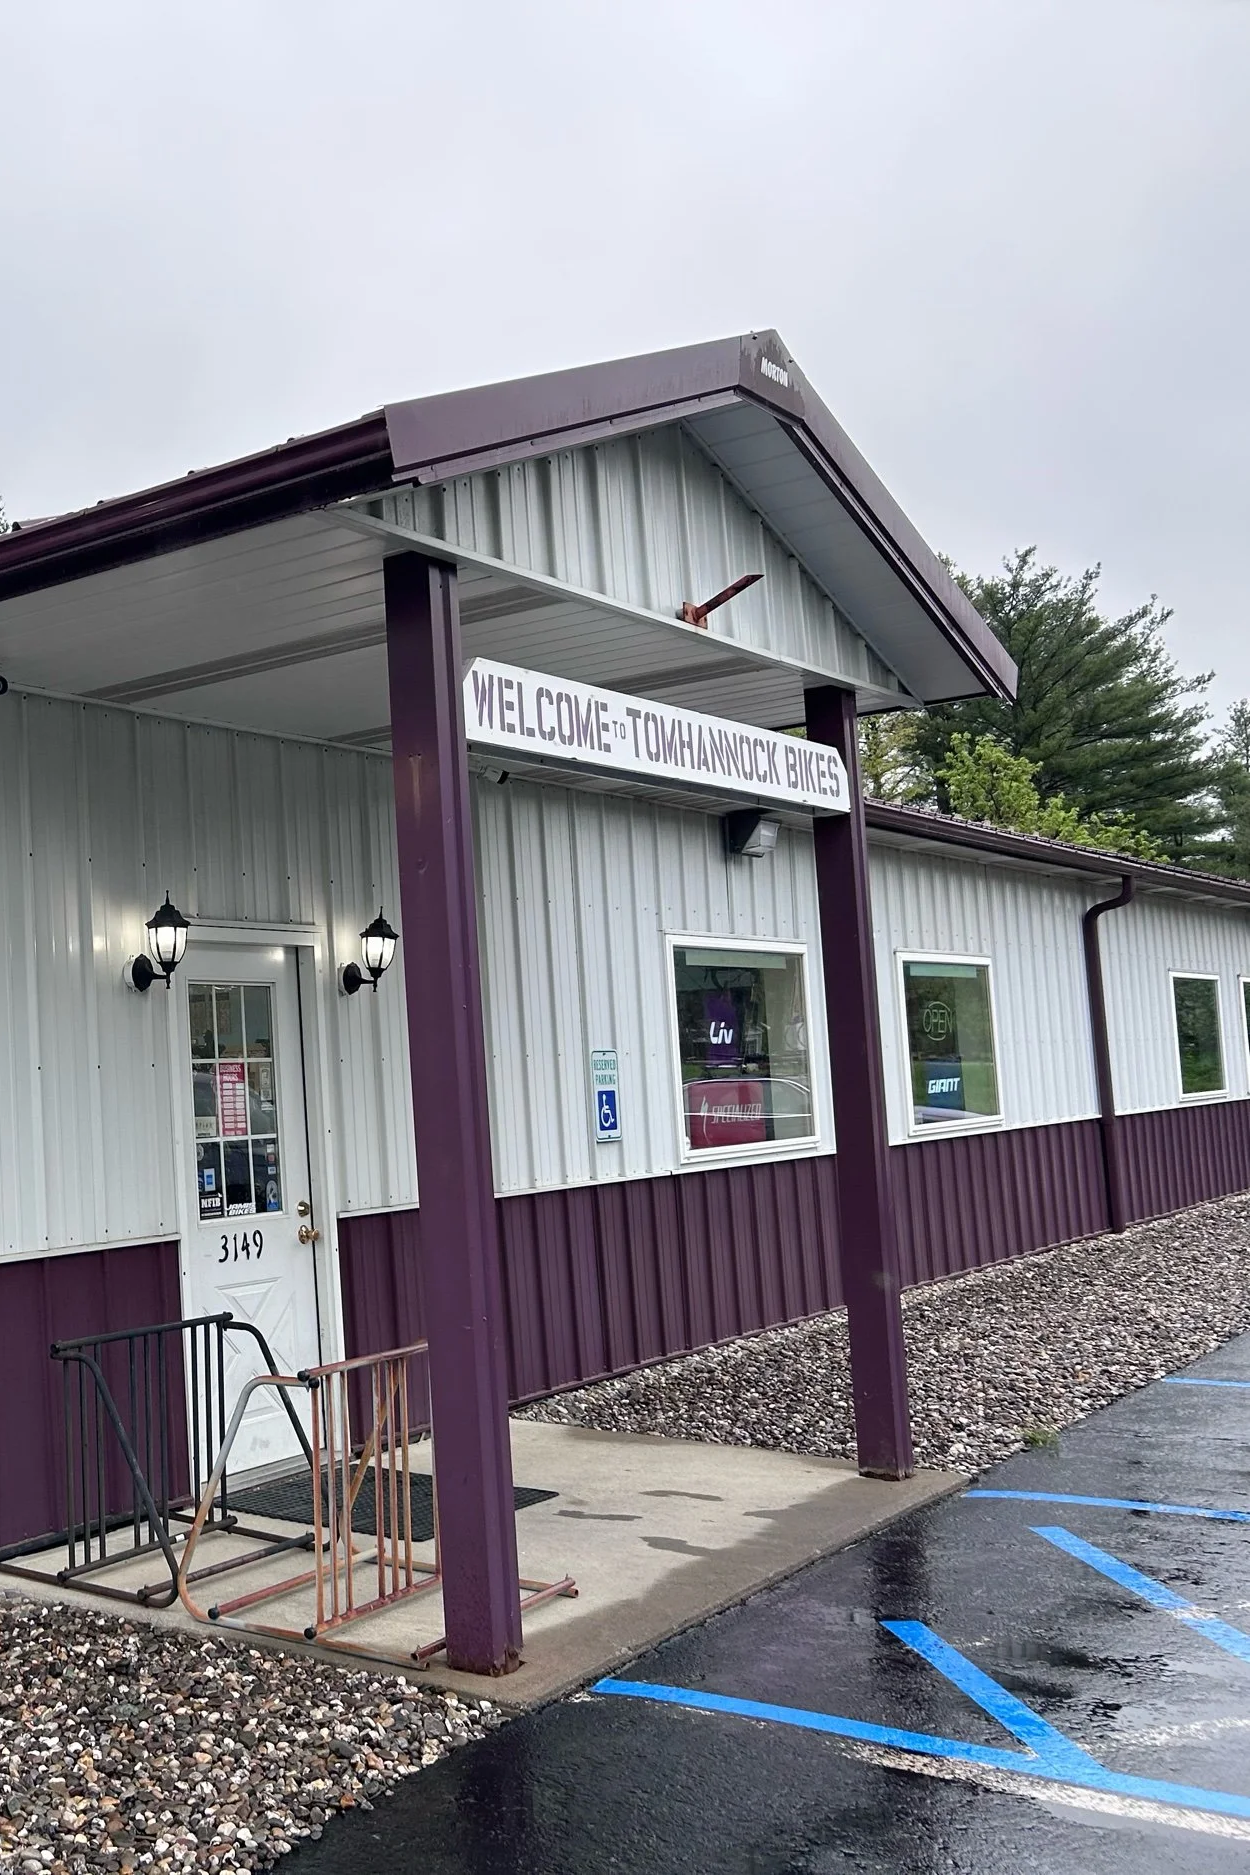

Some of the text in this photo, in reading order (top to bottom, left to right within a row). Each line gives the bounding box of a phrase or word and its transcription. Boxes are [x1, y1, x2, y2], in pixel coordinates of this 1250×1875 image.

[471, 669, 841, 798] WELCOME TO TOMHANNOCK BIKES
[923, 1009, 953, 1033] OPEN
[710, 1021, 733, 1044] Liv
[594, 1059, 615, 1070] RESERVED
[595, 1074, 616, 1085] PARKING
[928, 1077, 960, 1094] GIANT
[711, 1103, 761, 1123] SPECIALIZED
[218, 1229, 263, 1263] 3149
